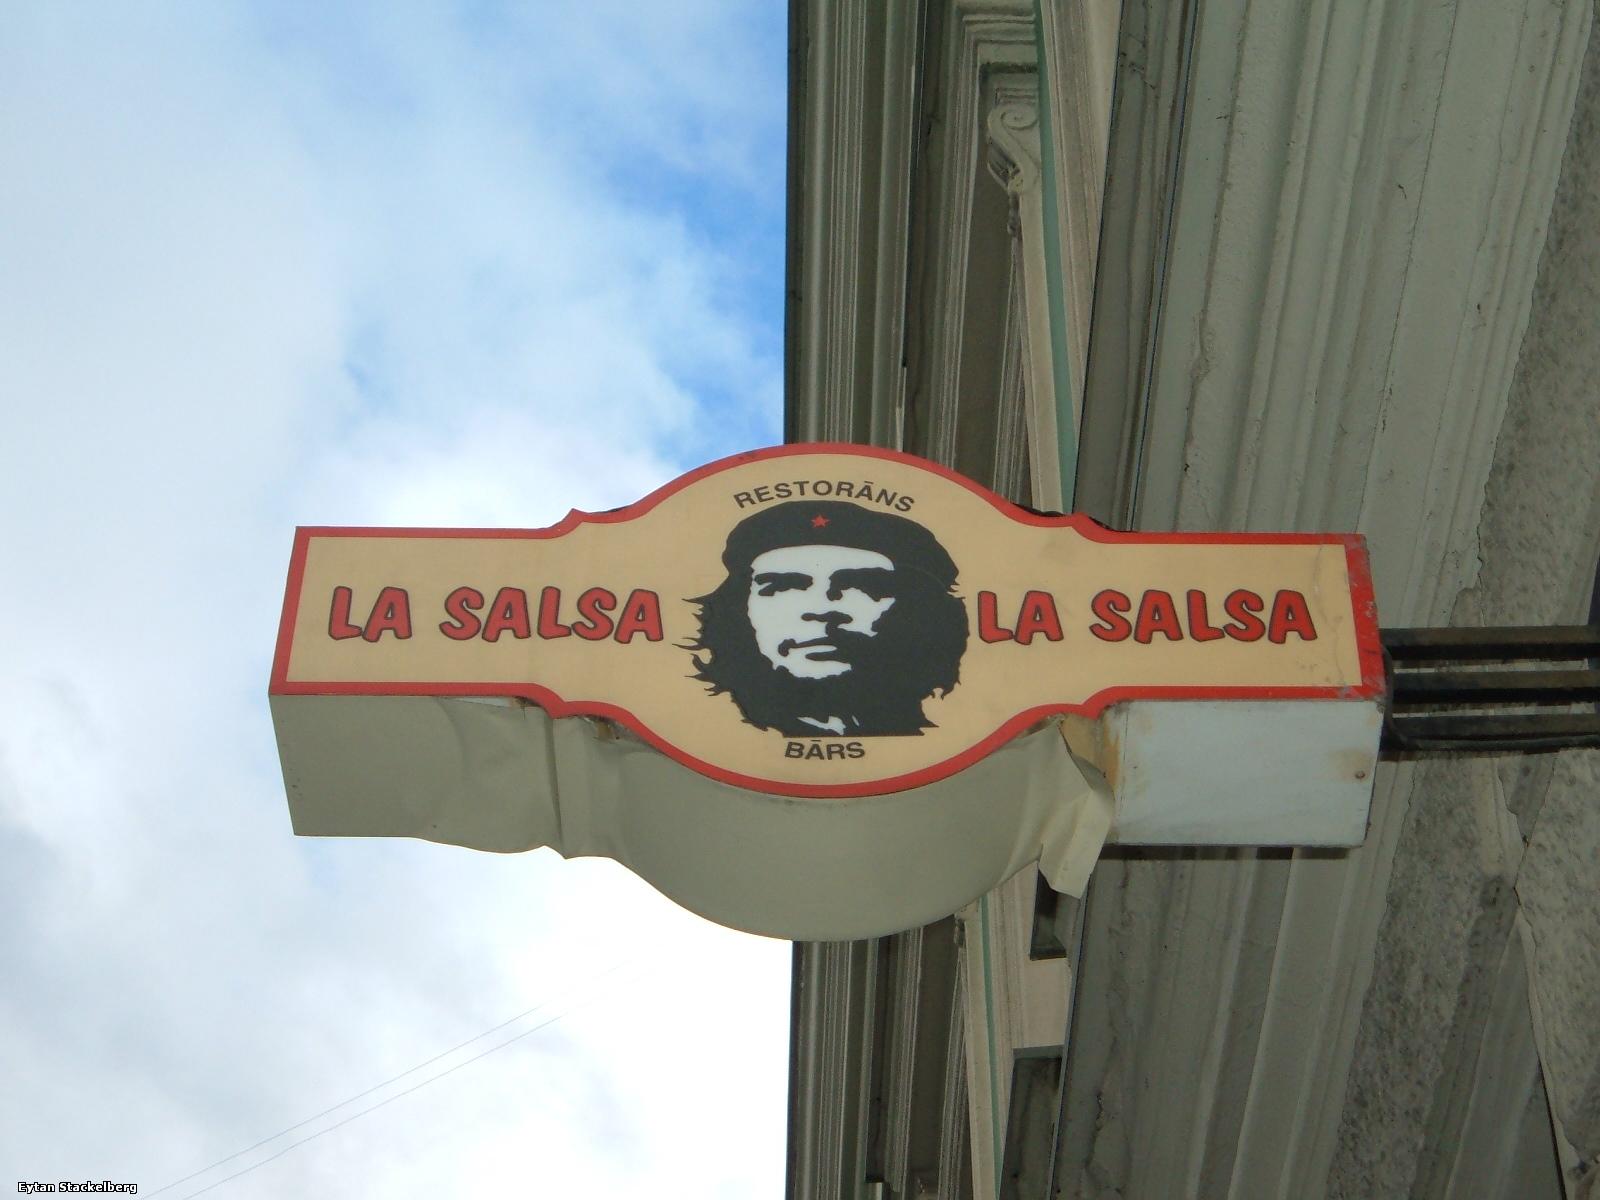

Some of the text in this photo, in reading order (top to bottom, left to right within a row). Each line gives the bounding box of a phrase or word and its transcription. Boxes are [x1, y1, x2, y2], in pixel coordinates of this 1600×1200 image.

[733, 480, 915, 512] RESTORĀNS
[328, 586, 664, 644] LA SALSA
[977, 589, 1318, 645] LA SALSA
[784, 738, 866, 761] BĀRS
